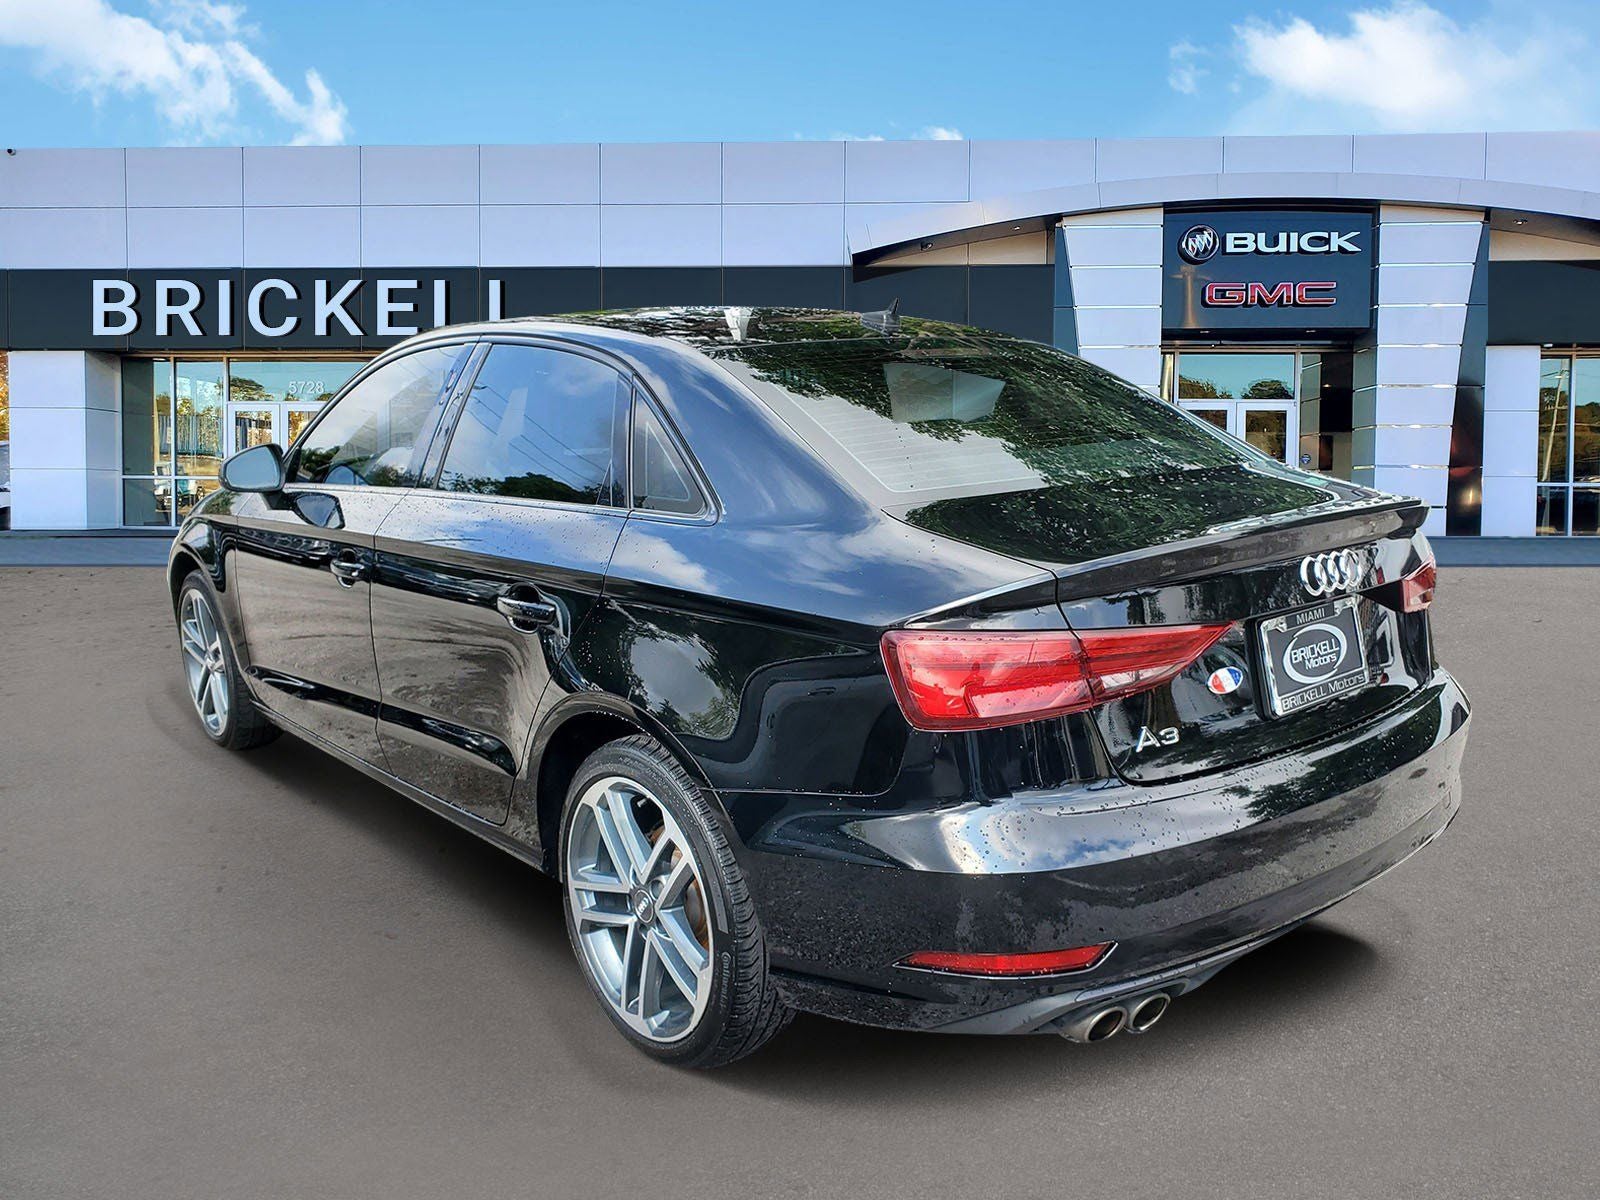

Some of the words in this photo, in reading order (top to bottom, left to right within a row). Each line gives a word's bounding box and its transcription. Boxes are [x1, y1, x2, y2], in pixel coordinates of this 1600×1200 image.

[1225, 231, 1362, 253] BUICK
[1206, 281, 1337, 305] GMC
[288, 380, 325, 395] 5728
[1296, 608, 1326, 625] MIAMI
[1291, 638, 1340, 664] BRICKELL
[1305, 652, 1338, 670] Motors
[1281, 686, 1327, 711] BRICKELL
[1328, 671, 1366, 696] Motors
[1135, 726, 1180, 753] A3
